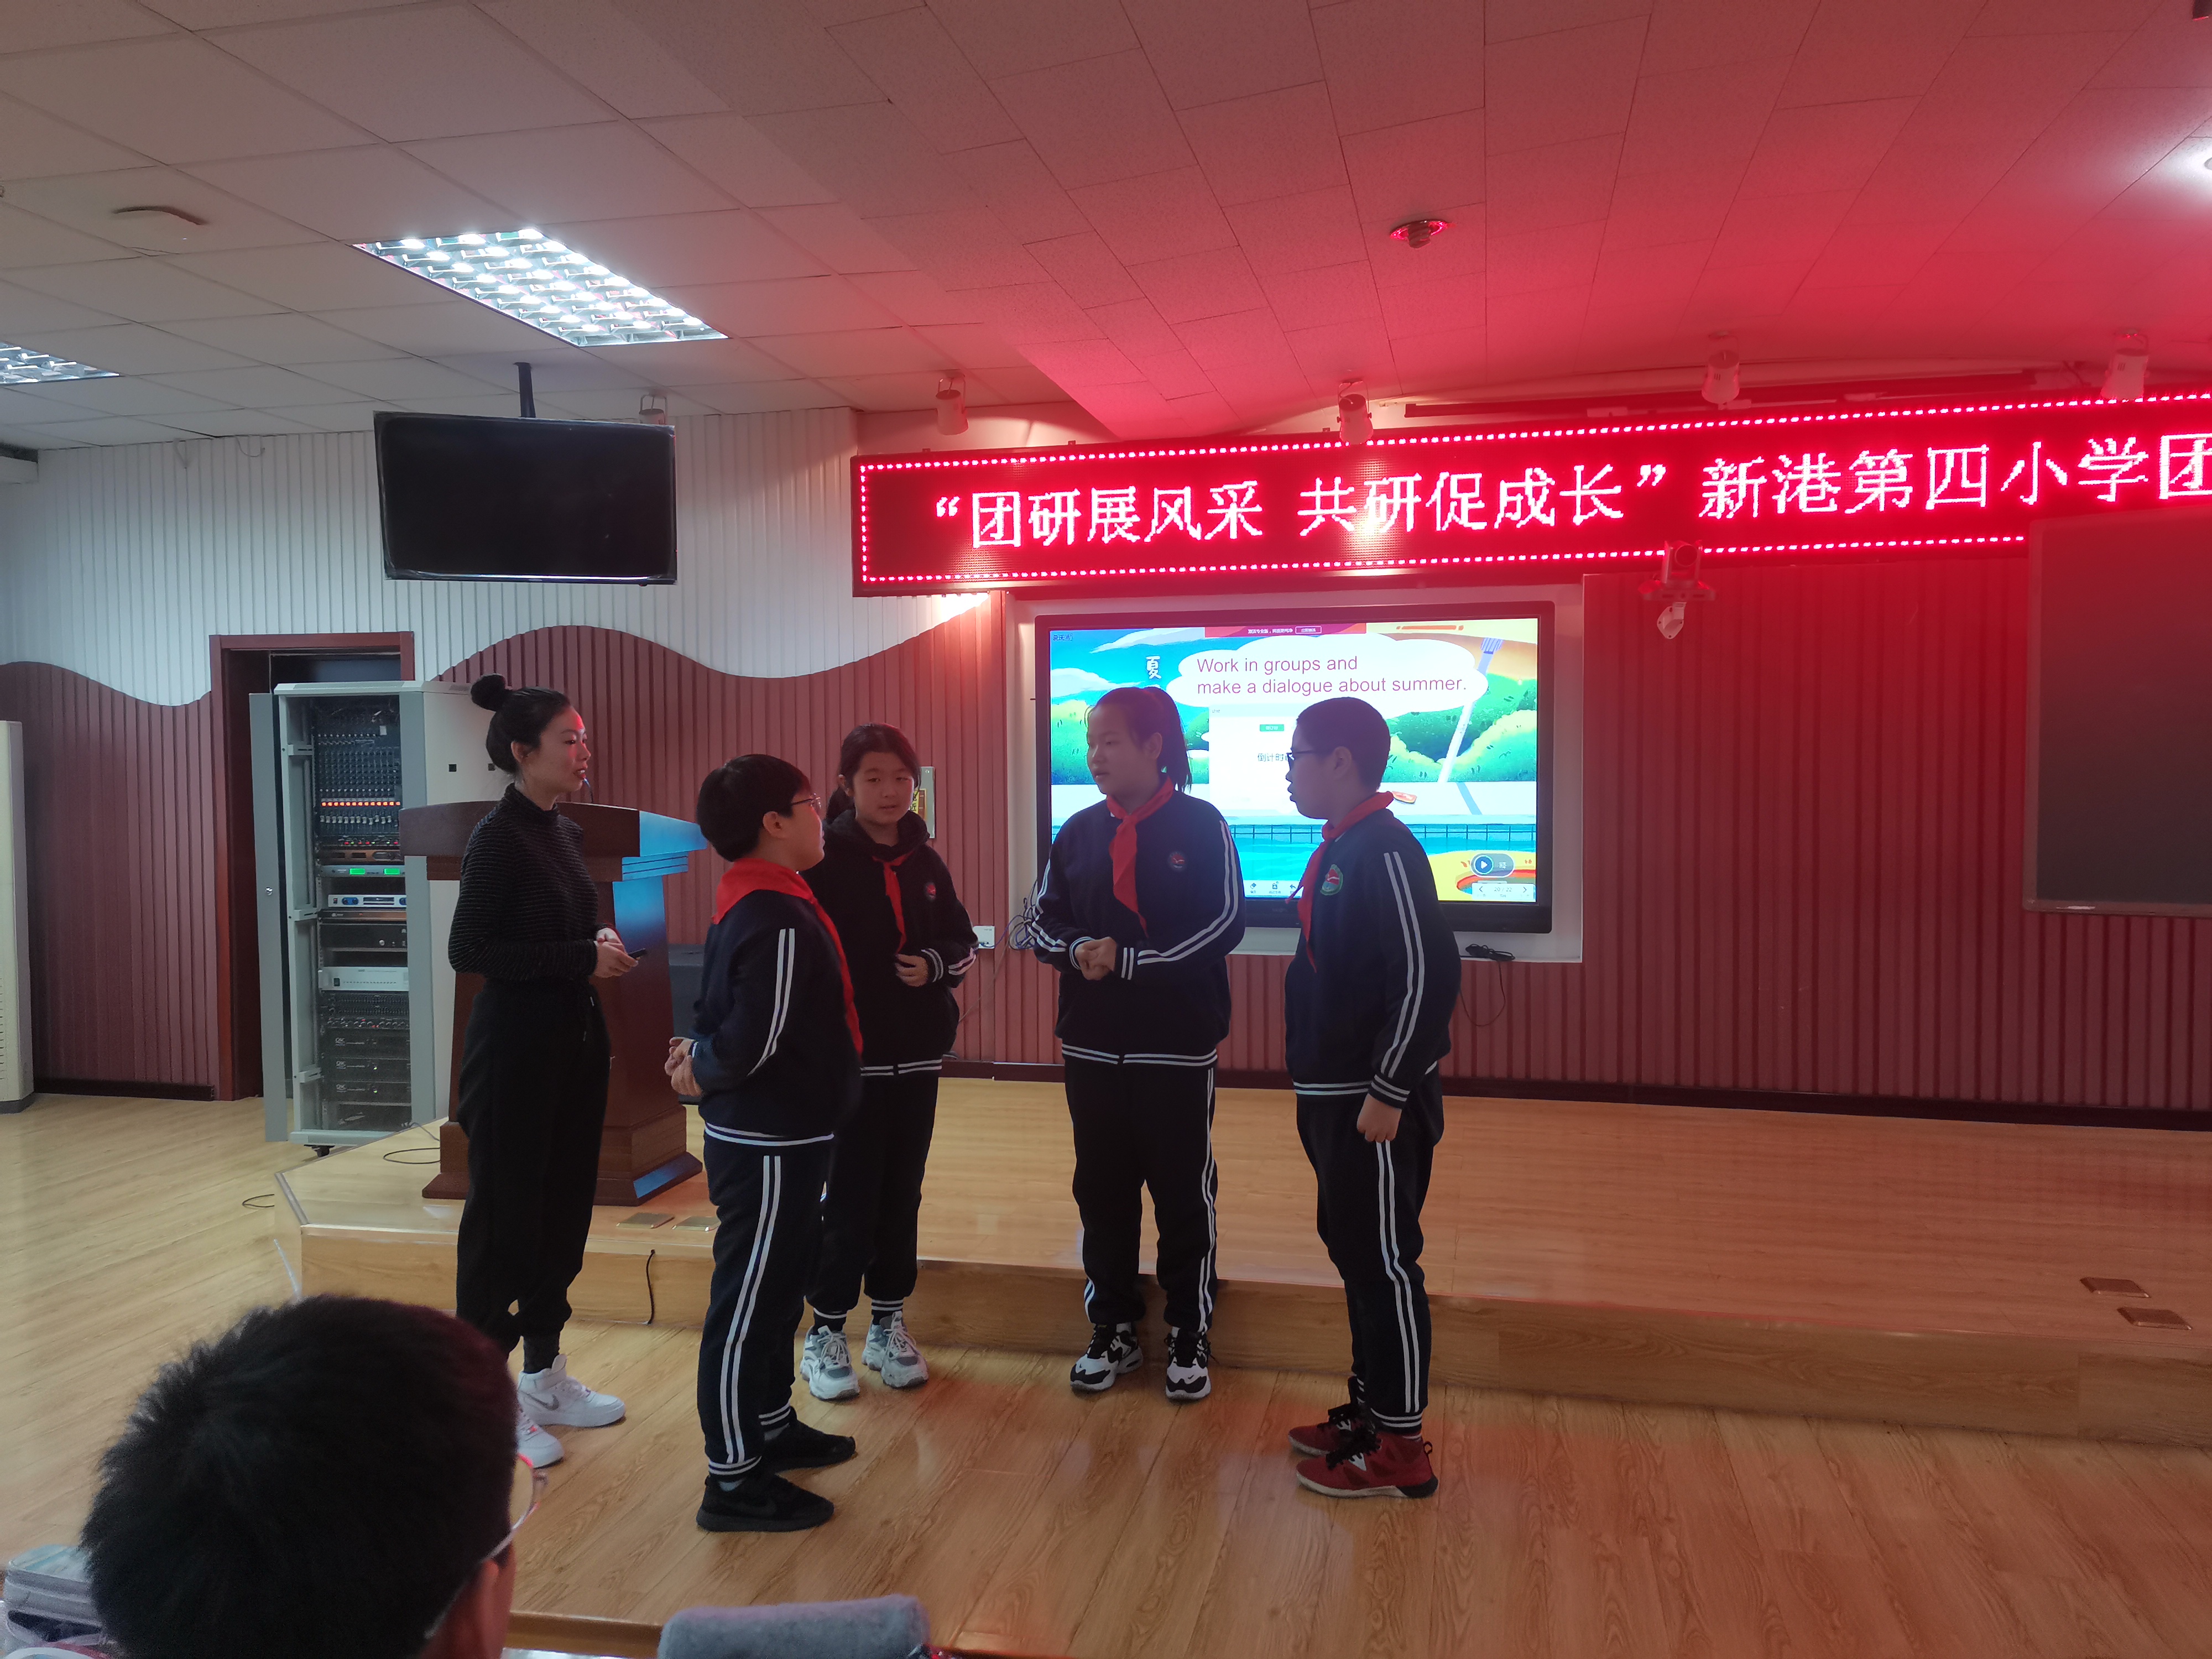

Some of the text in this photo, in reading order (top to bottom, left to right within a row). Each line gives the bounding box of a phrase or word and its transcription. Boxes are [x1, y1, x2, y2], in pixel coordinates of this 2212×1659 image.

[936, 433, 2212, 549] “团研展风采 共研促成长” 新港第四小学团
[1145, 655, 1162, 680] 夏
[1197, 656, 1358, 675] Work in groups and
[1197, 677, 1467, 696] make a dialogue about summer.
[1258, 753, 1288, 762] 倒计时
